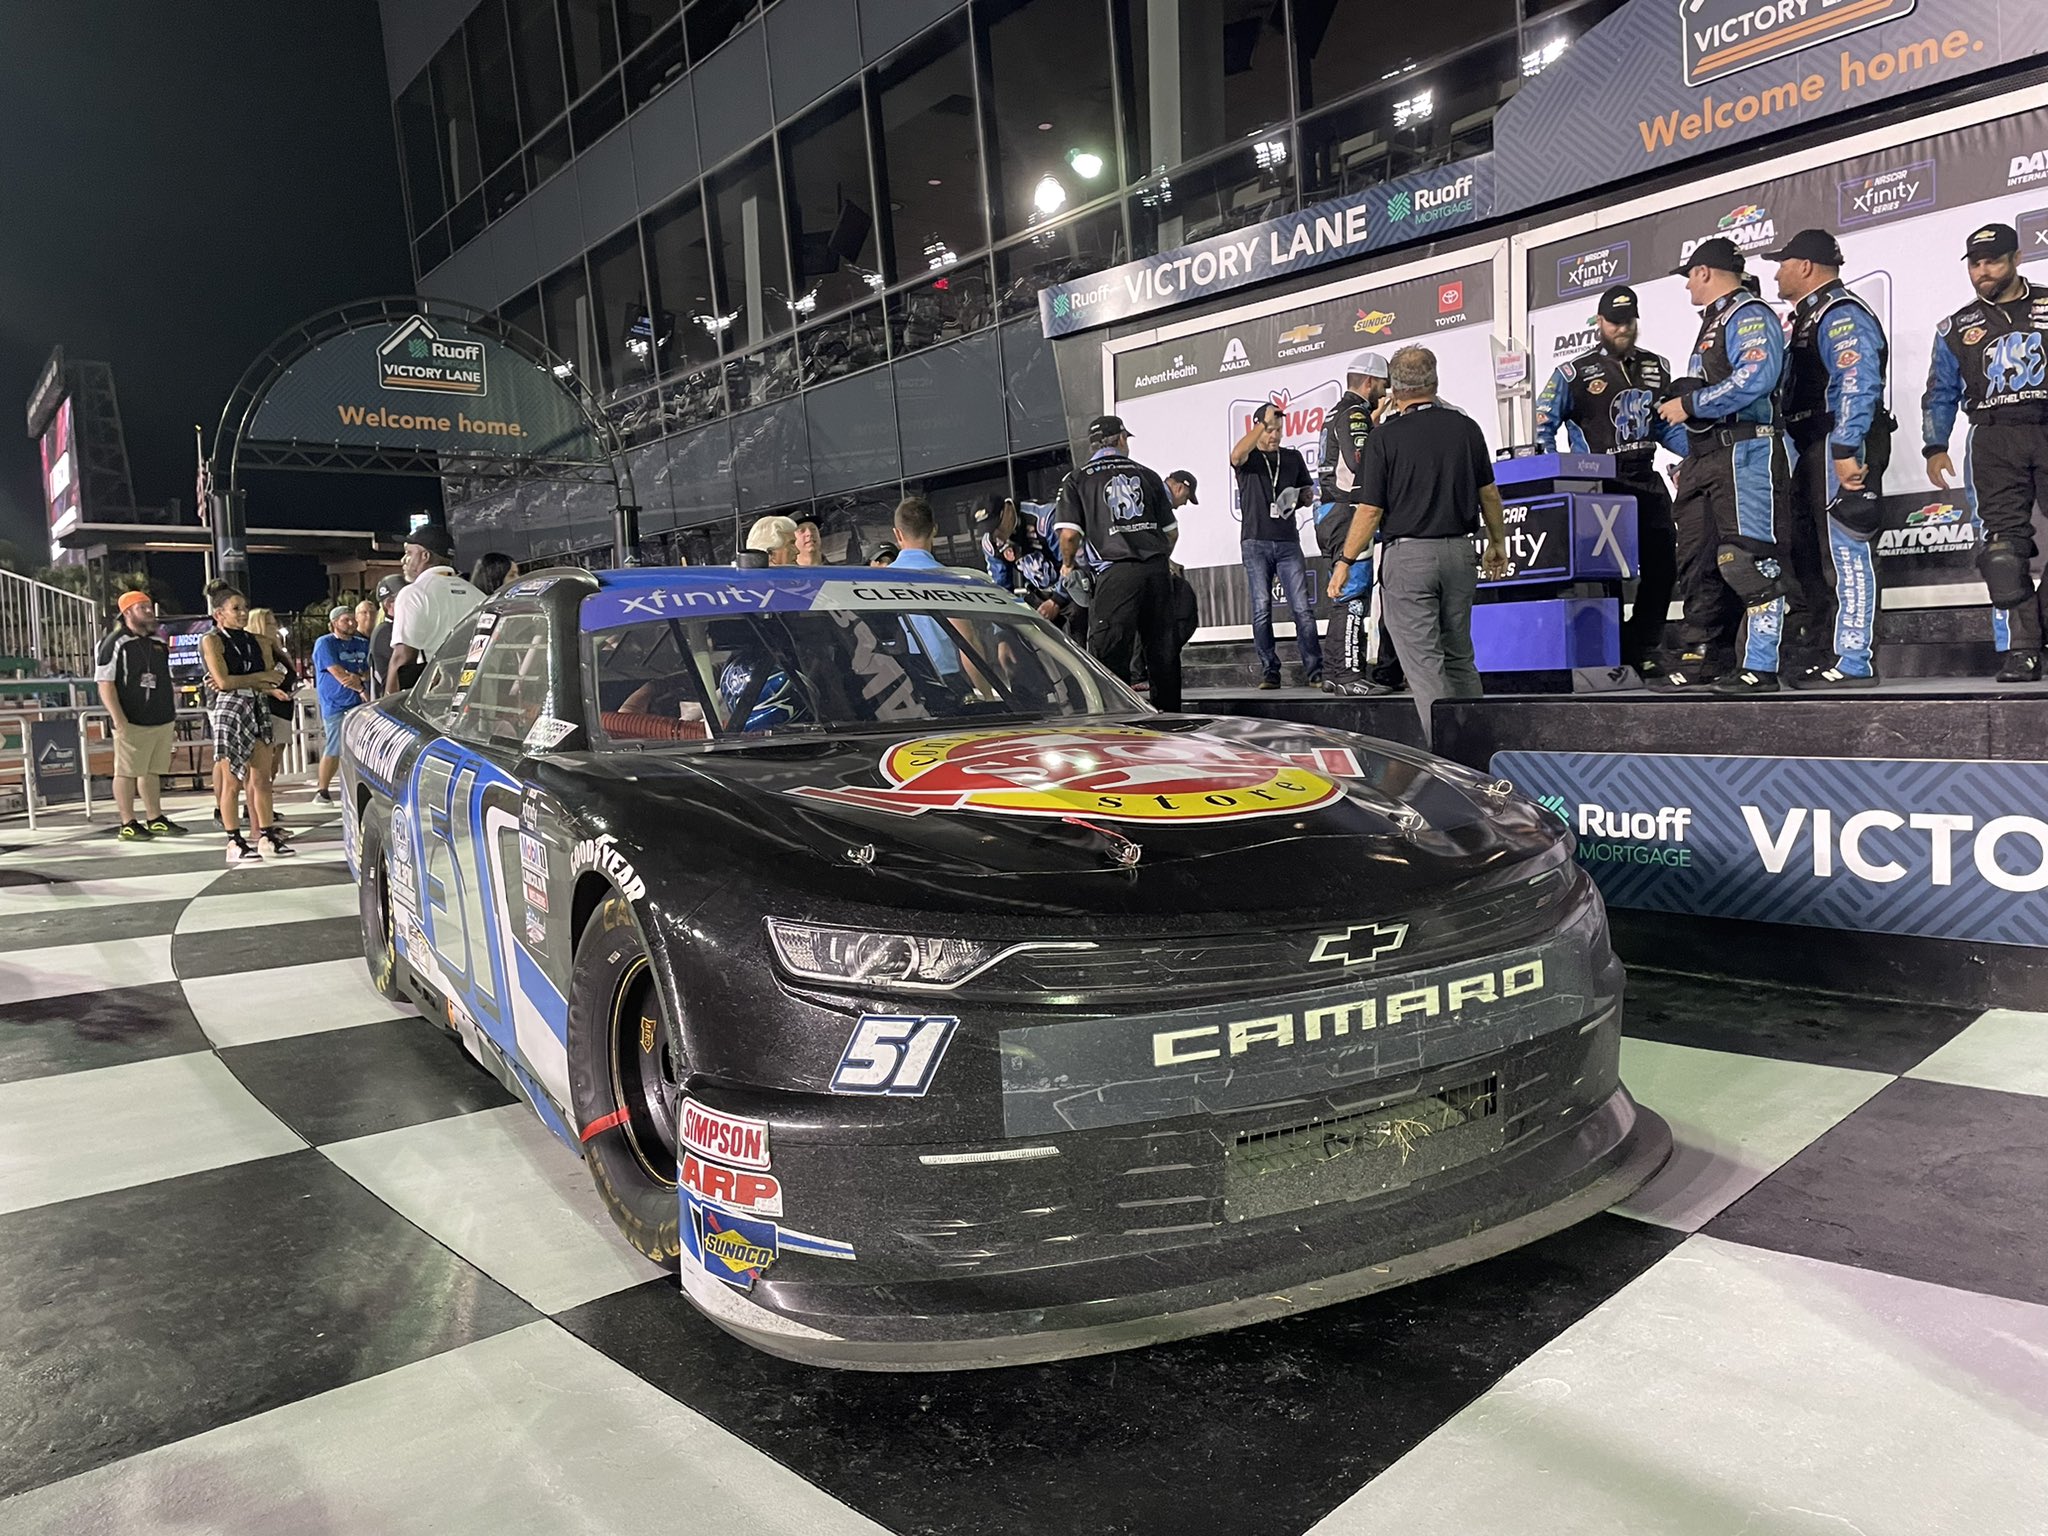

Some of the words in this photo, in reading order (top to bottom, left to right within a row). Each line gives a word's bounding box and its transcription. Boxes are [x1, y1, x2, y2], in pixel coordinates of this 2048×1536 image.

[1694, 0, 1807, 52] VICTORY
[1638, 73, 1826, 153] Welcome
[1840, 29, 1985, 91] home.
[1873, 170, 1908, 186] NASCAR
[1414, 175, 1473, 211] Ruoff
[1853, 180, 1919, 213] xfinity
[1414, 199, 1473, 225] MORTGAGE
[1872, 201, 1900, 215] SERIES
[1071, 284, 1111, 309] Ruoff
[1124, 237, 1260, 304] VICTORY
[1270, 204, 1368, 266] LANE
[1584, 249, 1610, 263] NASCAR
[1568, 259, 1619, 285] xfinity
[1355, 314, 1394, 331] SUNOCO
[1435, 314, 1466, 326] TOYOTA
[432, 342, 480, 361] Ruoff
[1277, 341, 1326, 358] CHEVROLET
[384, 363, 443, 381] VICTORY
[446, 369, 481, 383] LANE
[1134, 364, 1198, 389] AdventHealth
[1219, 359, 1251, 373] AXALTA
[338, 404, 451, 432] Welcome
[458, 412, 528, 438] home.
[1591, 504, 1631, 578] X
[1877, 523, 1975, 549] AYTONA
[1928, 542, 1975, 554] SPEEDWAY
[618, 585, 775, 615] xfinity
[852, 588, 1008, 605] CLEMENTS
[1097, 780, 1307, 811] store
[1578, 803, 1692, 842] Ruoff
[1740, 805, 2048, 893] VICTO
[1578, 842, 1692, 869] MORTGAGE
[570, 834, 646, 903] GOODYEAR
[1152, 959, 1545, 1068] CAMARO
[831, 1014, 961, 1097] 51
[684, 1107, 762, 1160] SIMPSON
[681, 1154, 779, 1207] ARP
[706, 1235, 772, 1267] SUNOCO
